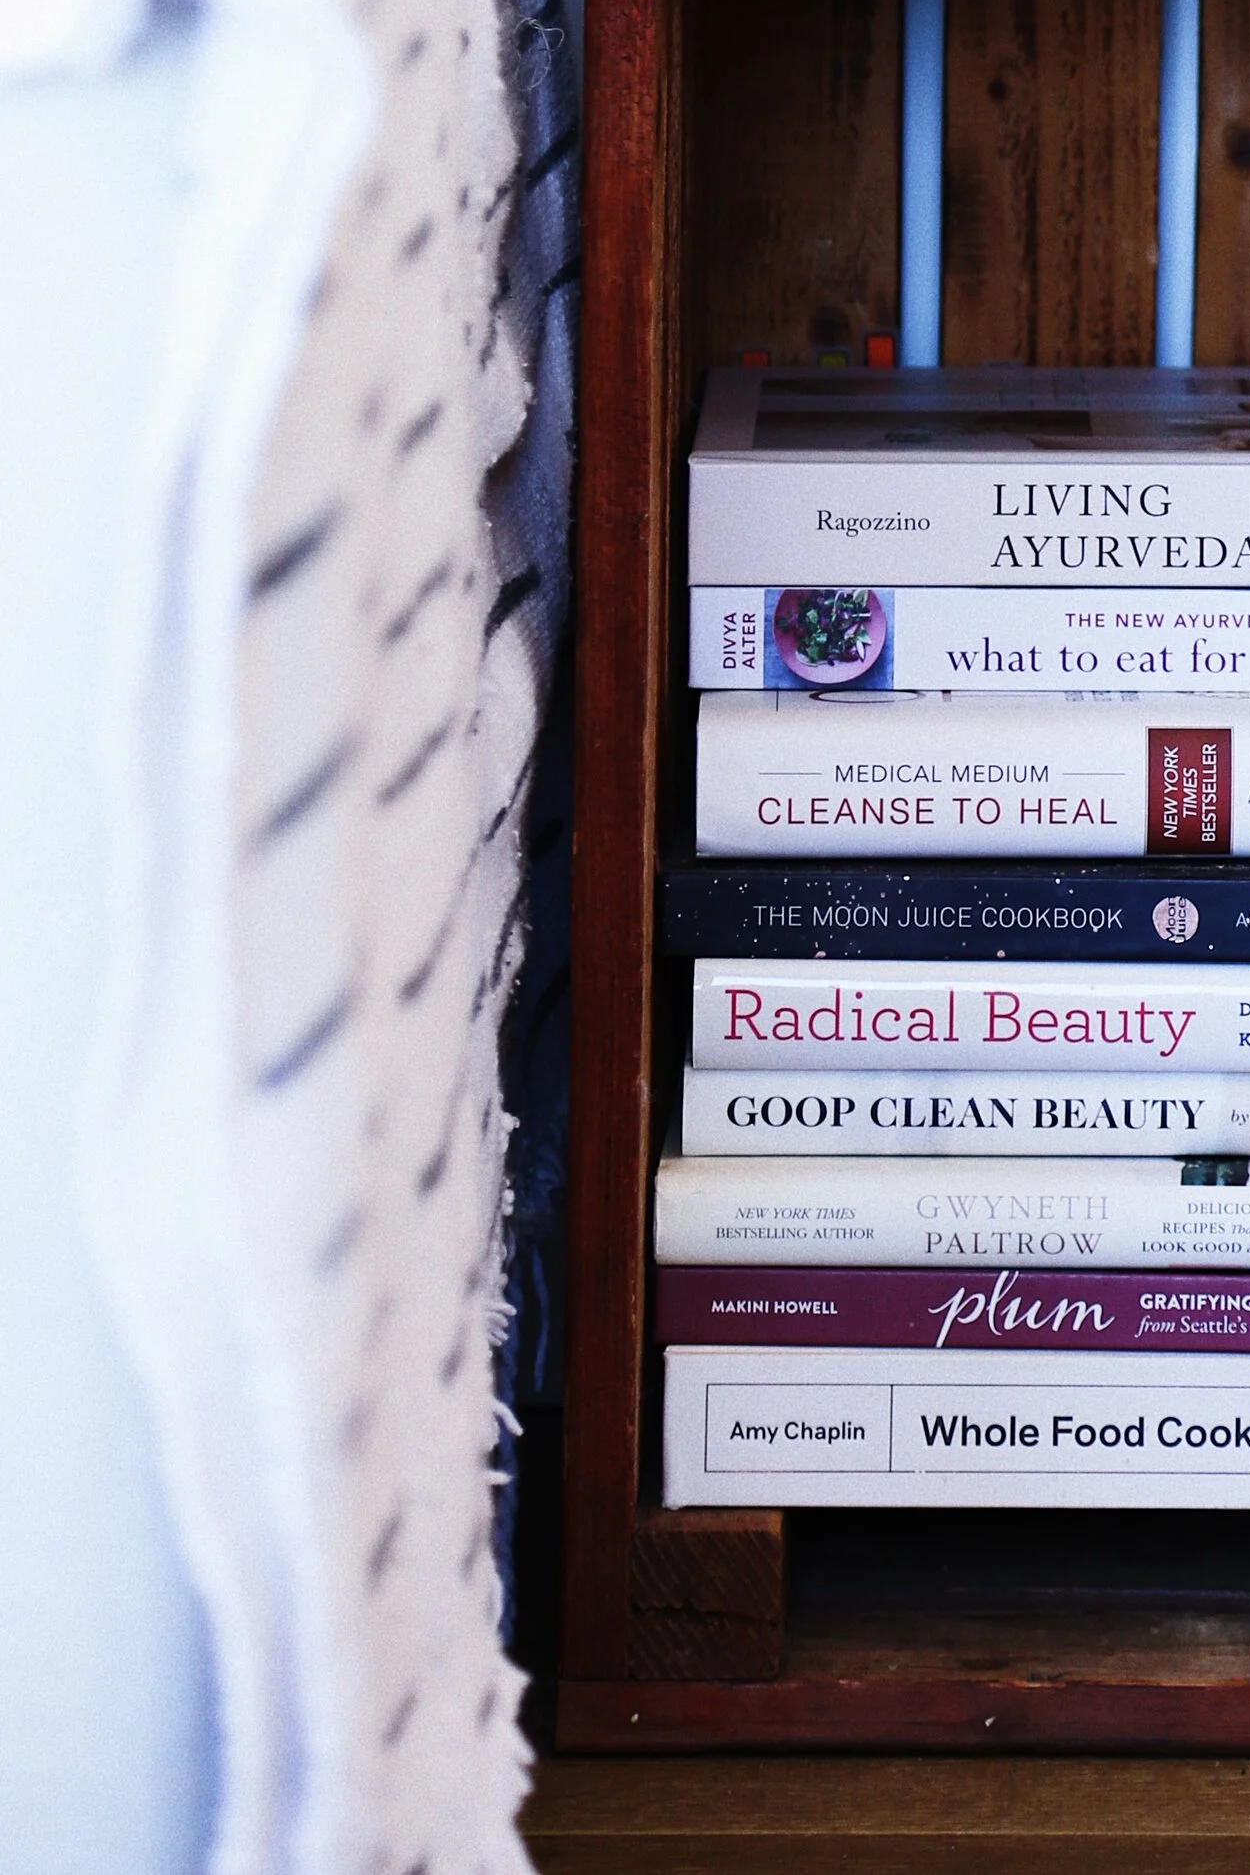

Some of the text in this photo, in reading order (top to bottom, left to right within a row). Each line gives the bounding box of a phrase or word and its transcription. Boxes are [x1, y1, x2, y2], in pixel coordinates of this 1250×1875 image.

[993, 484, 1172, 517] LIVING
[816, 509, 931, 537] Ragozzino
[1065, 612, 1106, 629] THE
[1116, 612, 1165, 629] NEW
[722, 612, 737, 669] DIVYA
[741, 612, 756, 670] ALTER
[946, 636, 1042, 673] what
[1059, 643, 1099, 673] to
[1115, 643, 1174, 673] eat
[1190, 636, 1246, 673] for
[834, 765, 1049, 783] MEDICAL MEDIUM
[1164, 746, 1179, 838] NEW YORK
[1183, 767, 1198, 818] TIMES
[1202, 743, 1217, 842] BESTSELLER
[758, 798, 1118, 825] CLEANSE TO HEAL
[753, 906, 1123, 929] THE MOON JUICE COOKBOOK
[1166, 896, 1176, 941] Moon
[1175, 896, 1187, 942] Juice
[724, 987, 1197, 1057] Radical Beauty
[727, 1095, 856, 1127] GOOP
[869, 1097, 1018, 1129] CLEAN
[1033, 1099, 1204, 1130] BEAUTY
[1231, 1108, 1249, 1125] by
[735, 1208, 856, 1220] NEW YORK TIMES
[916, 1195, 1109, 1221] GWYNETH
[716, 1227, 874, 1240] BESTSELLING AUTHOR
[1162, 1222, 1226, 1234] RECIPES
[926, 1232, 1103, 1255] PALTROW
[1142, 1241, 1187, 1253] LOOK
[1193, 1242, 1242, 1253] GOOD
[711, 1300, 838, 1315] MAKINI HOWELL
[928, 1271, 1115, 1347] plum
[1134, 1316, 1176, 1338] from
[730, 1422, 778, 1443] Amy
[784, 1422, 866, 1443] Chaplin
[921, 1416, 1039, 1447] Whole
[1052, 1417, 1145, 1447] Food
